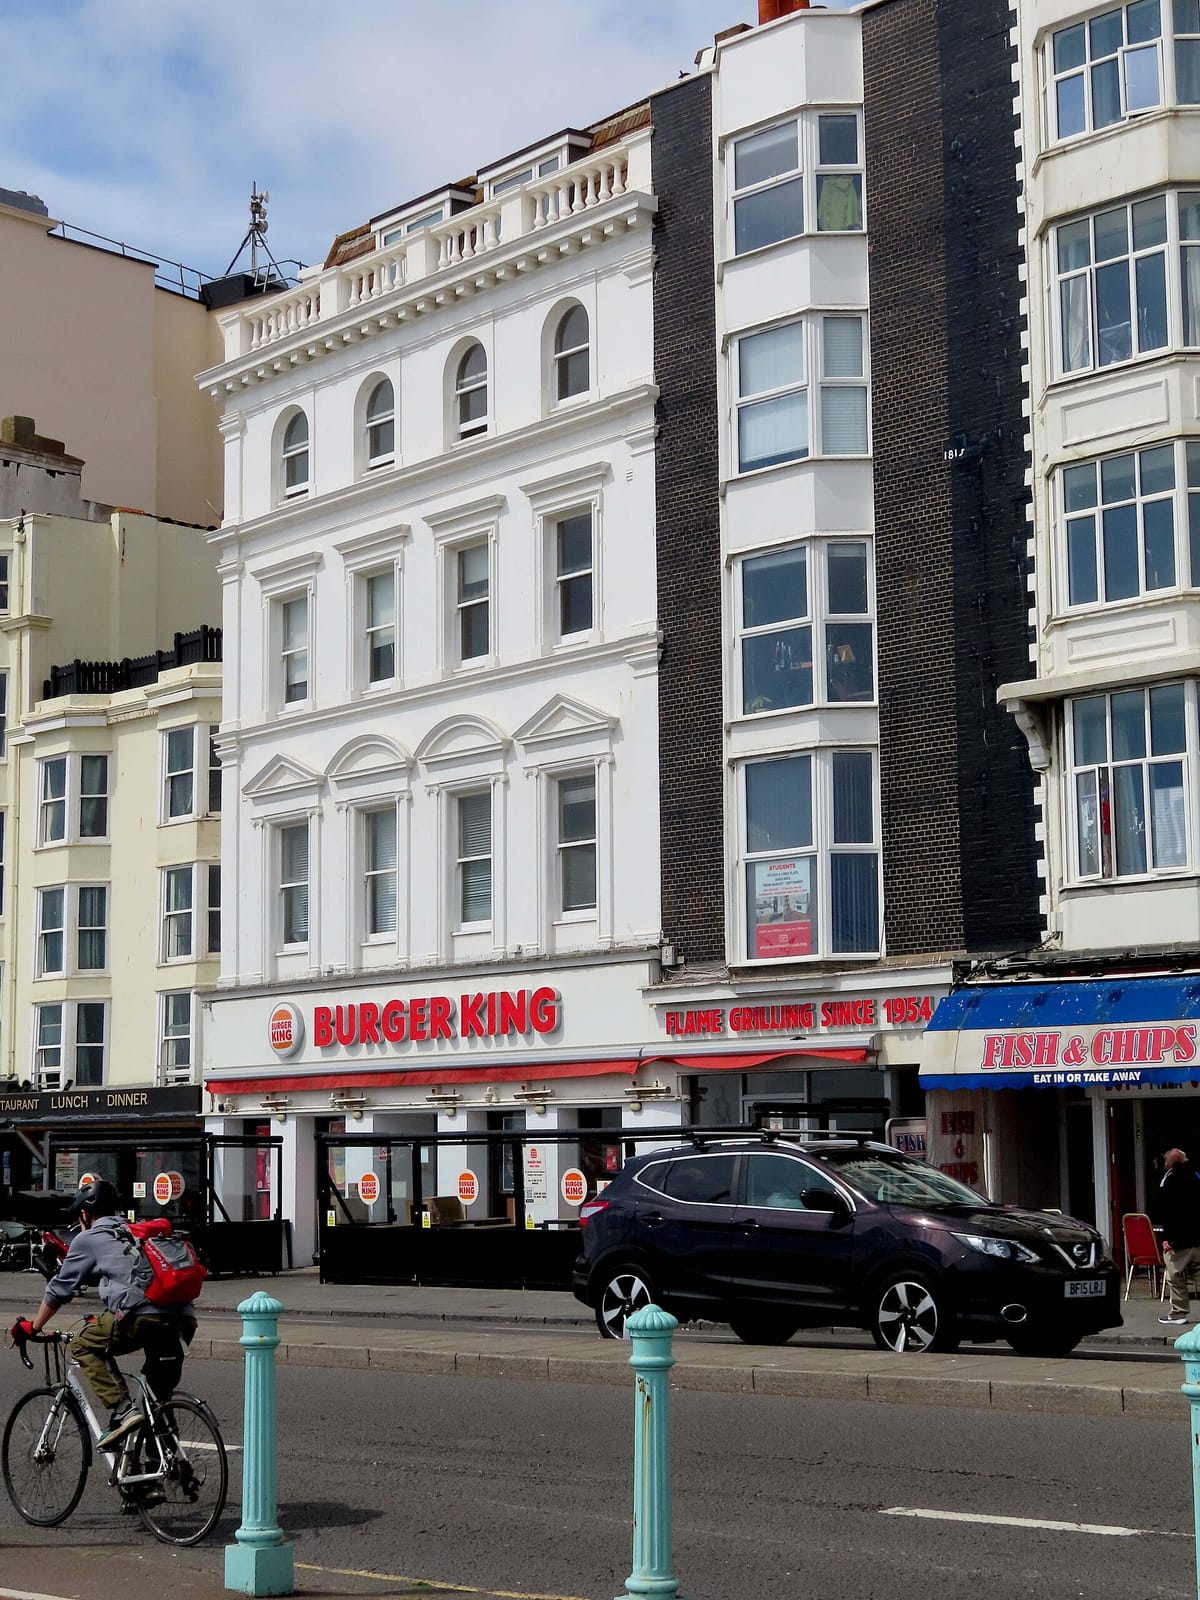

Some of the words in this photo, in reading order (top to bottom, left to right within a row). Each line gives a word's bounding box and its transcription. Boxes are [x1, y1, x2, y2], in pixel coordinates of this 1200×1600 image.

[769, 863, 796, 871] STUDENTS
[314, 996, 452, 1048] BURGER
[461, 987, 557, 1037] KING
[665, 1009, 722, 1035] FLAME
[729, 1003, 813, 1031] GRILLING
[821, 1000, 874, 1027] SINCE
[883, 996, 932, 1023] 1954
[272, 1021, 292, 1030] BURGER
[272, 1030, 292, 1042] KING
[981, 1031, 1061, 1069] FISH
[1062, 1036, 1088, 1066] &
[1092, 1025, 1197, 1065] CHIPS
[1033, 1073, 1051, 1084] EAT
[1053, 1073, 1064, 1083] IN
[1066, 1072, 1082, 1083] OR
[1083, 1072, 1109, 1083] TAKE
[1112, 1071, 1142, 1082] AWAY
[51, 1096, 89, 1109] LUNCH
[107, 1093, 148, 1107] DINNER
[565, 1187, 583, 1195] KING
[1070, 1282, 1088, 1295] BF15
[1089, 1281, 1103, 1294] LRJ
